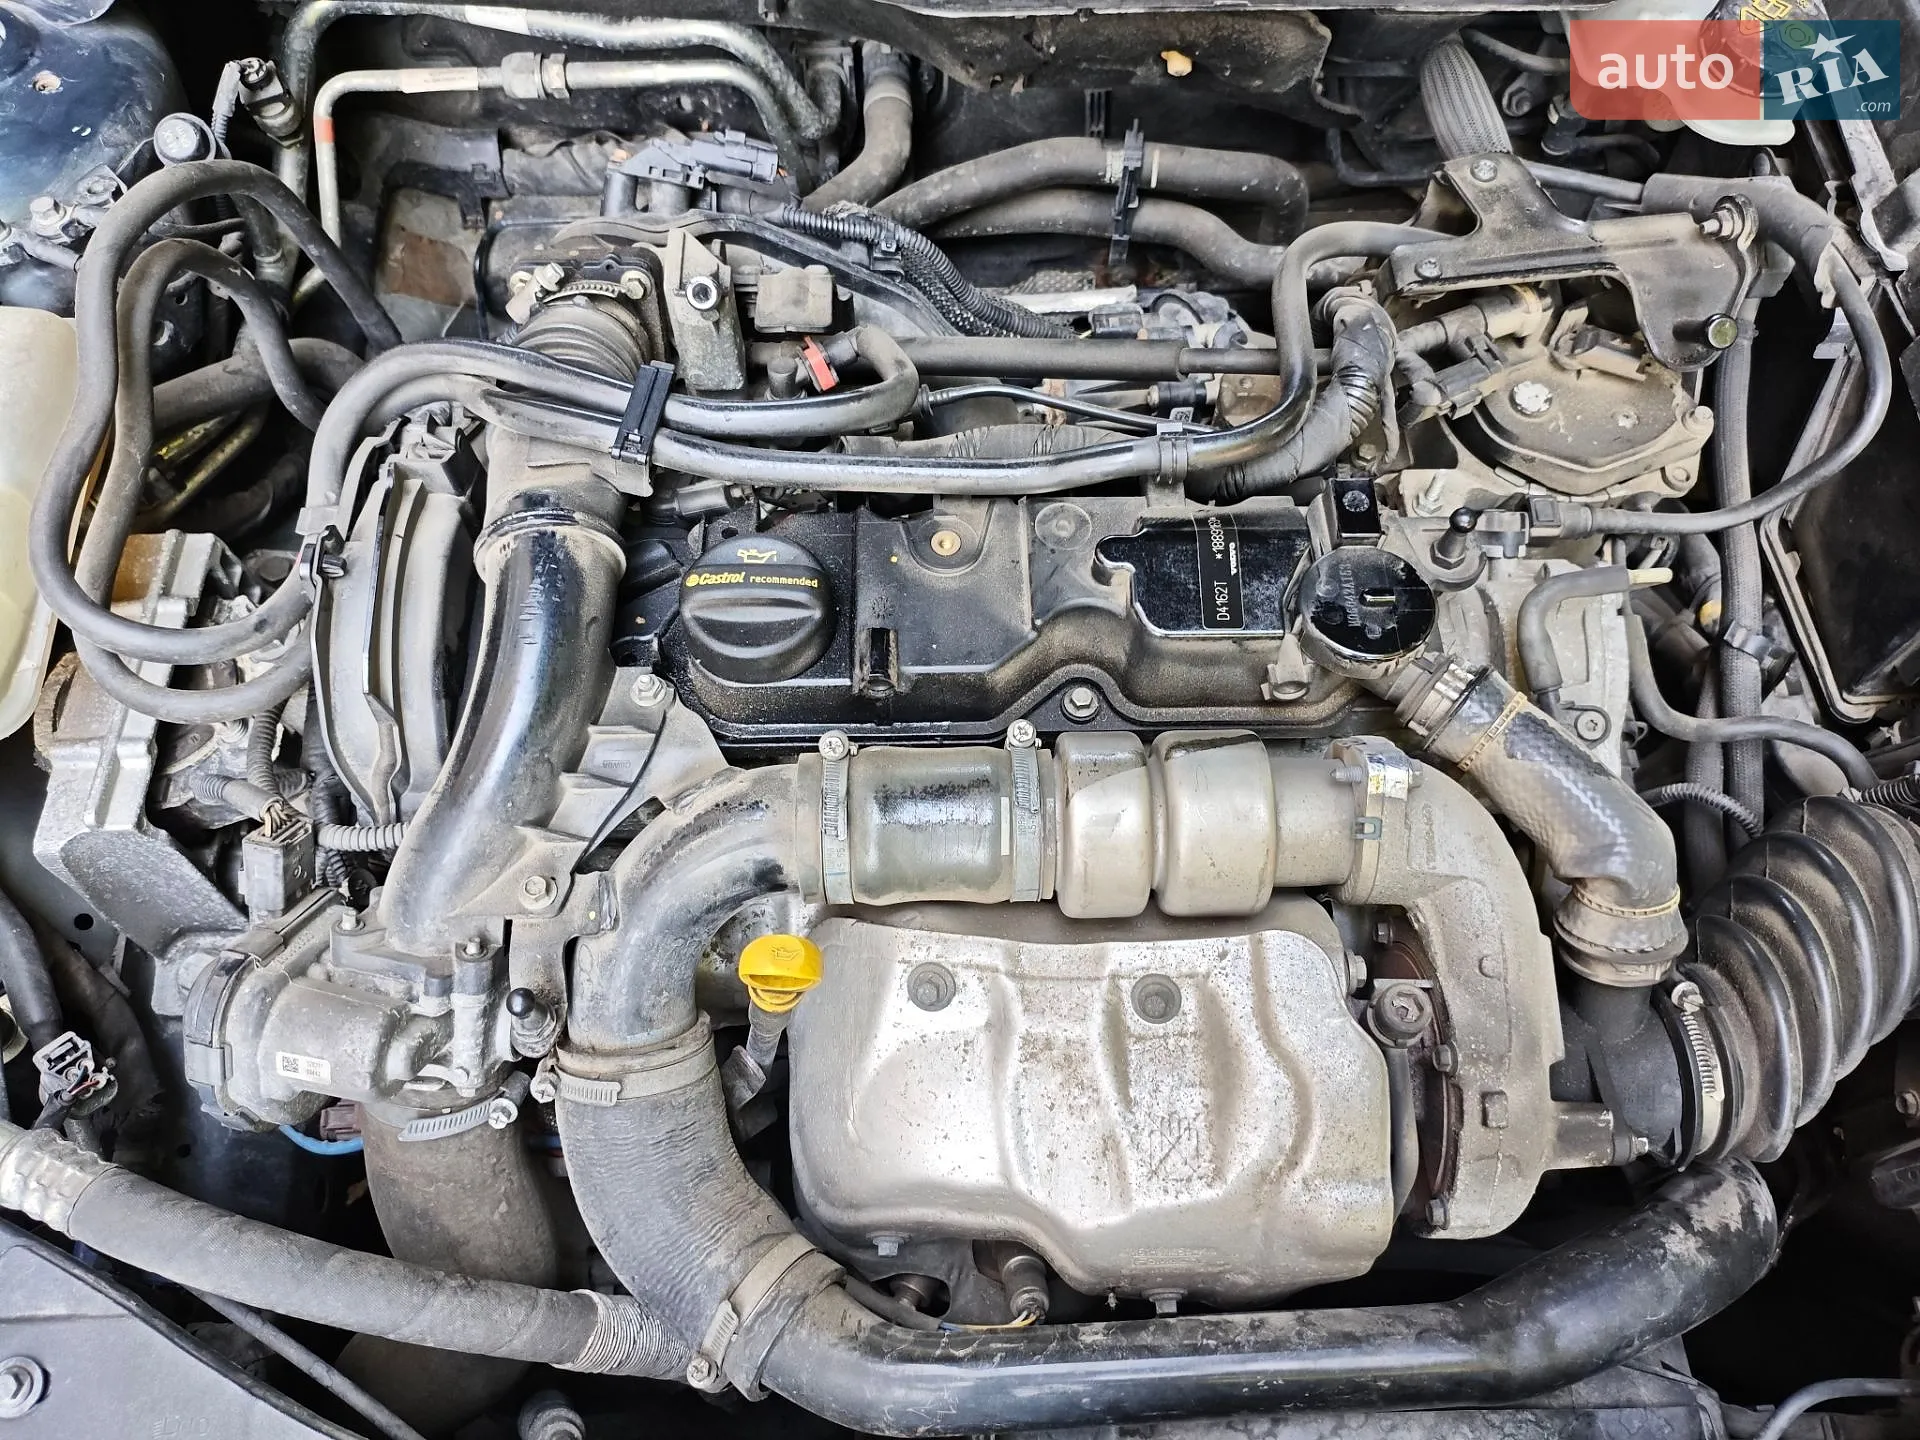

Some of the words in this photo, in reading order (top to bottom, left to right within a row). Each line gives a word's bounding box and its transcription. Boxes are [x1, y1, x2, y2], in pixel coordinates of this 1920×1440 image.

[1228, 542, 1238, 576] VOLVO
[698, 572, 746, 585] Castrol
[749, 575, 818, 588] recommended
[1213, 580, 1230, 621] D4162T
